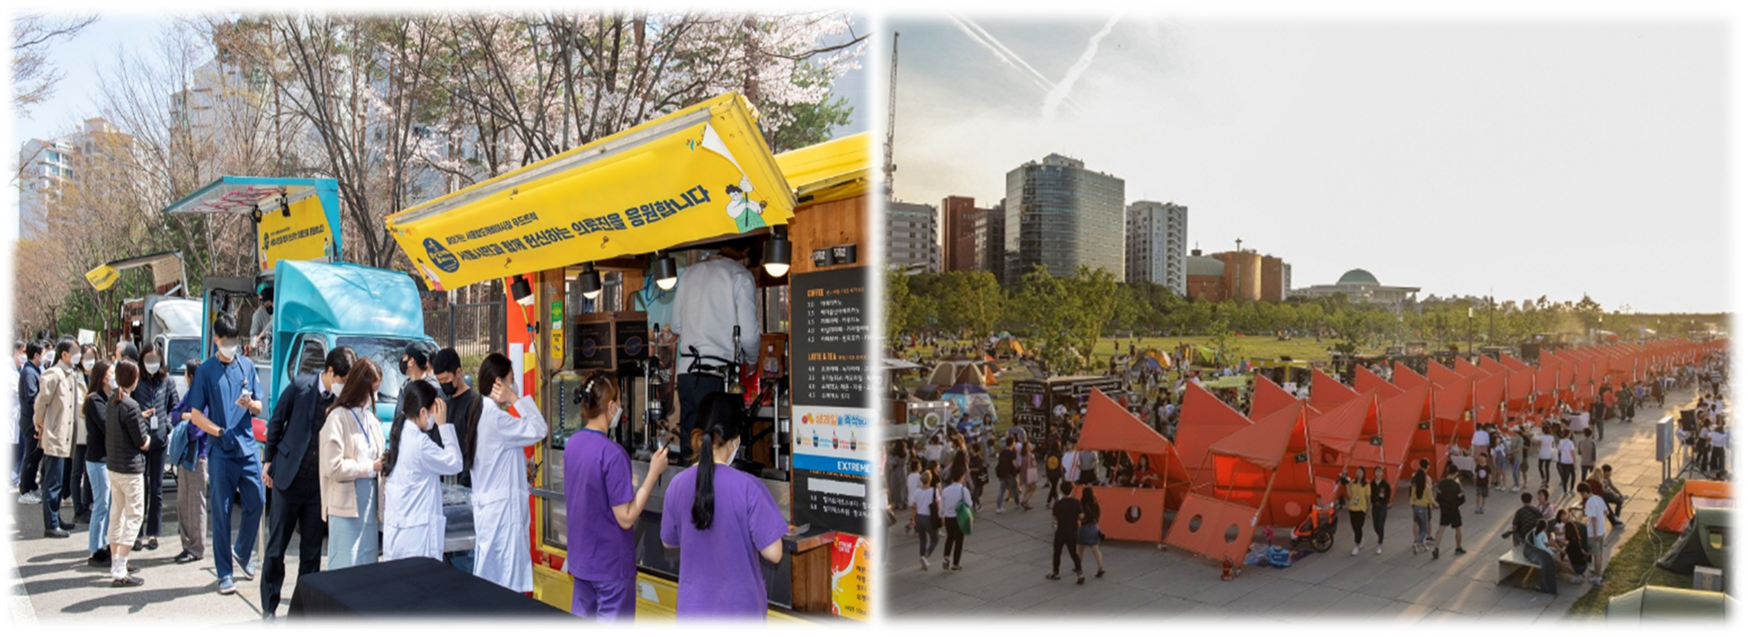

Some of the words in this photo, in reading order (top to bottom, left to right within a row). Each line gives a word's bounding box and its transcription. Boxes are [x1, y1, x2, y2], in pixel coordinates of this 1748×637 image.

[456, 243, 506, 261] 서울시민과
[501, 237, 528, 253] 함께
[523, 226, 575, 249] 헌신하는
[570, 212, 628, 236] 의료진을
[625, 184, 712, 228] 응원합니다
[807, 288, 824, 297] COFFEE
[827, 352, 837, 361] TEA
[837, 460, 871, 473] EXTREME
